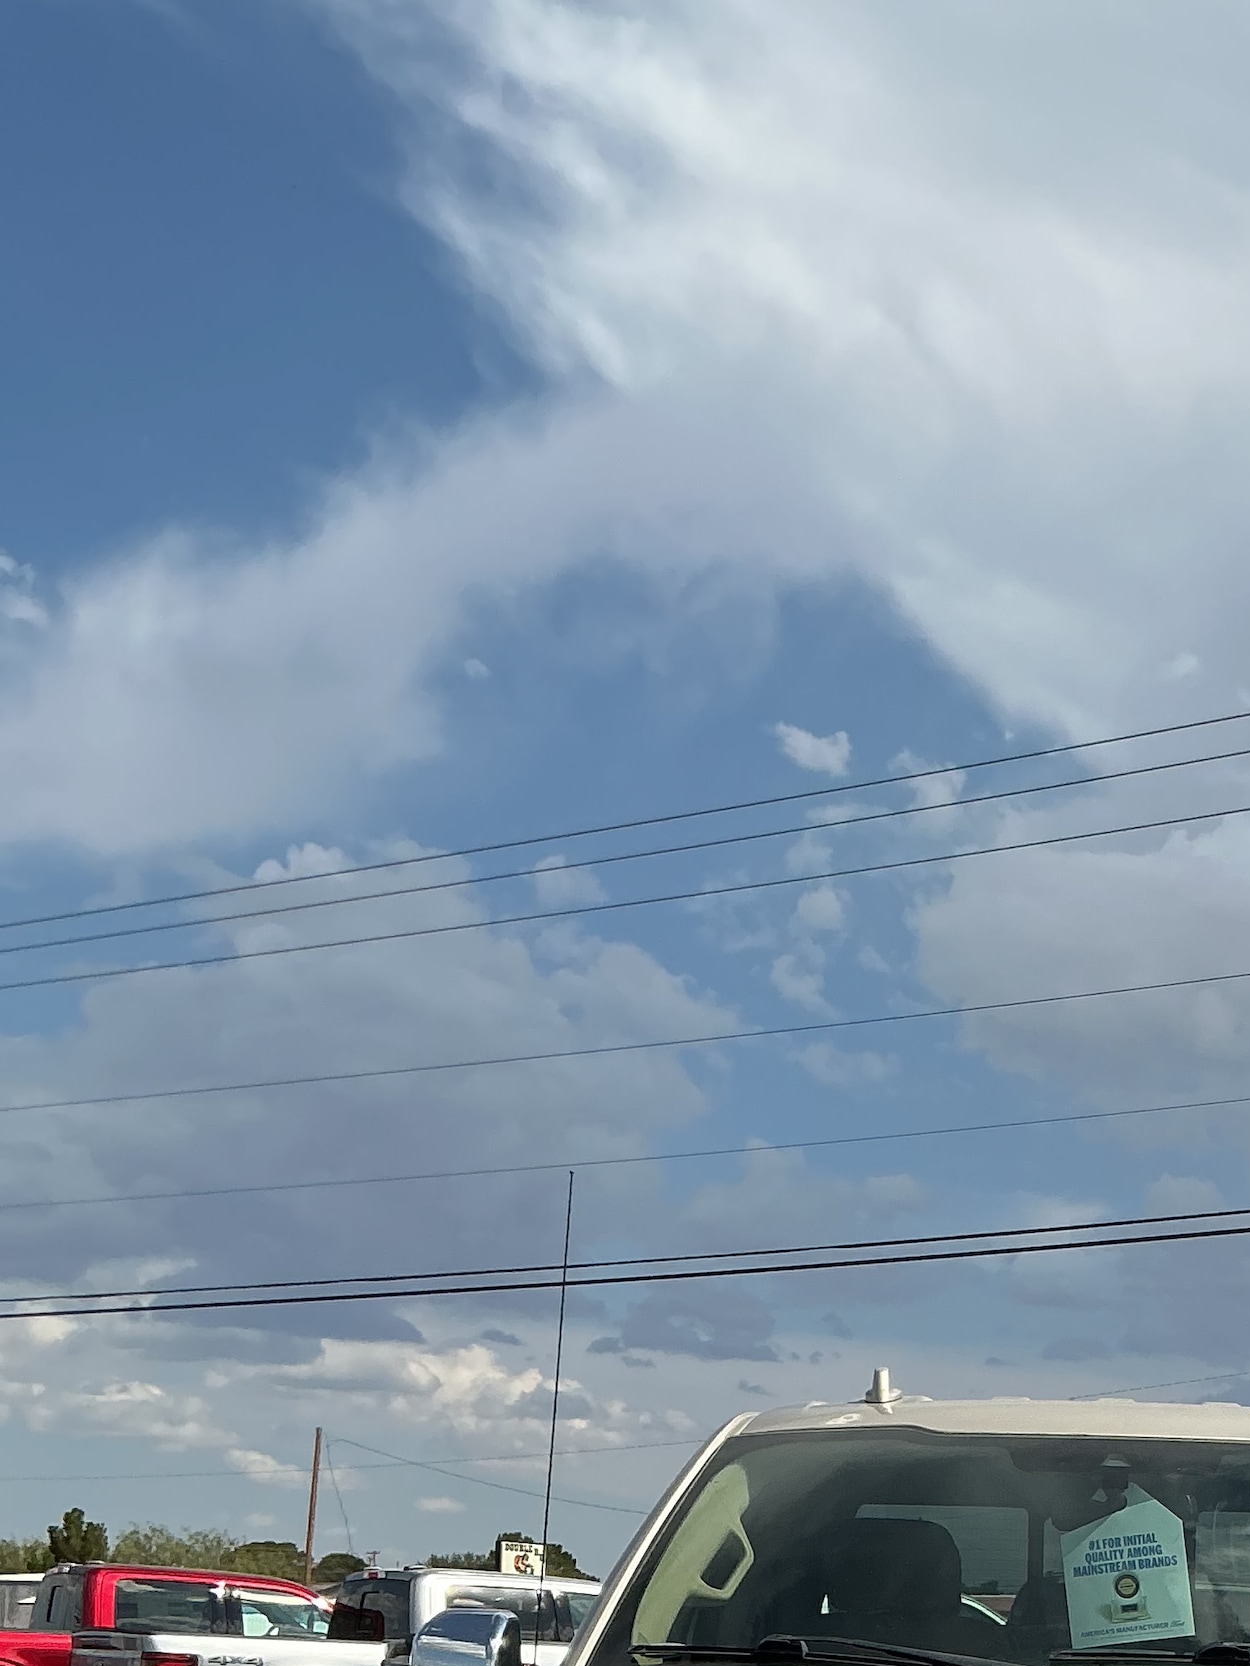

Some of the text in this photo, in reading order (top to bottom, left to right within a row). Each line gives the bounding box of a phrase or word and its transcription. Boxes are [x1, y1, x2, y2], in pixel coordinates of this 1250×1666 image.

[1088, 1532, 1158, 1551] #1 FOR INITIAL
[1085, 1544, 1163, 1565] QUALITY AMONG
[1073, 1555, 1178, 1577] MAINSTREAM BRANDS
[1116, 1622, 1169, 1633] MANUFACTURER
